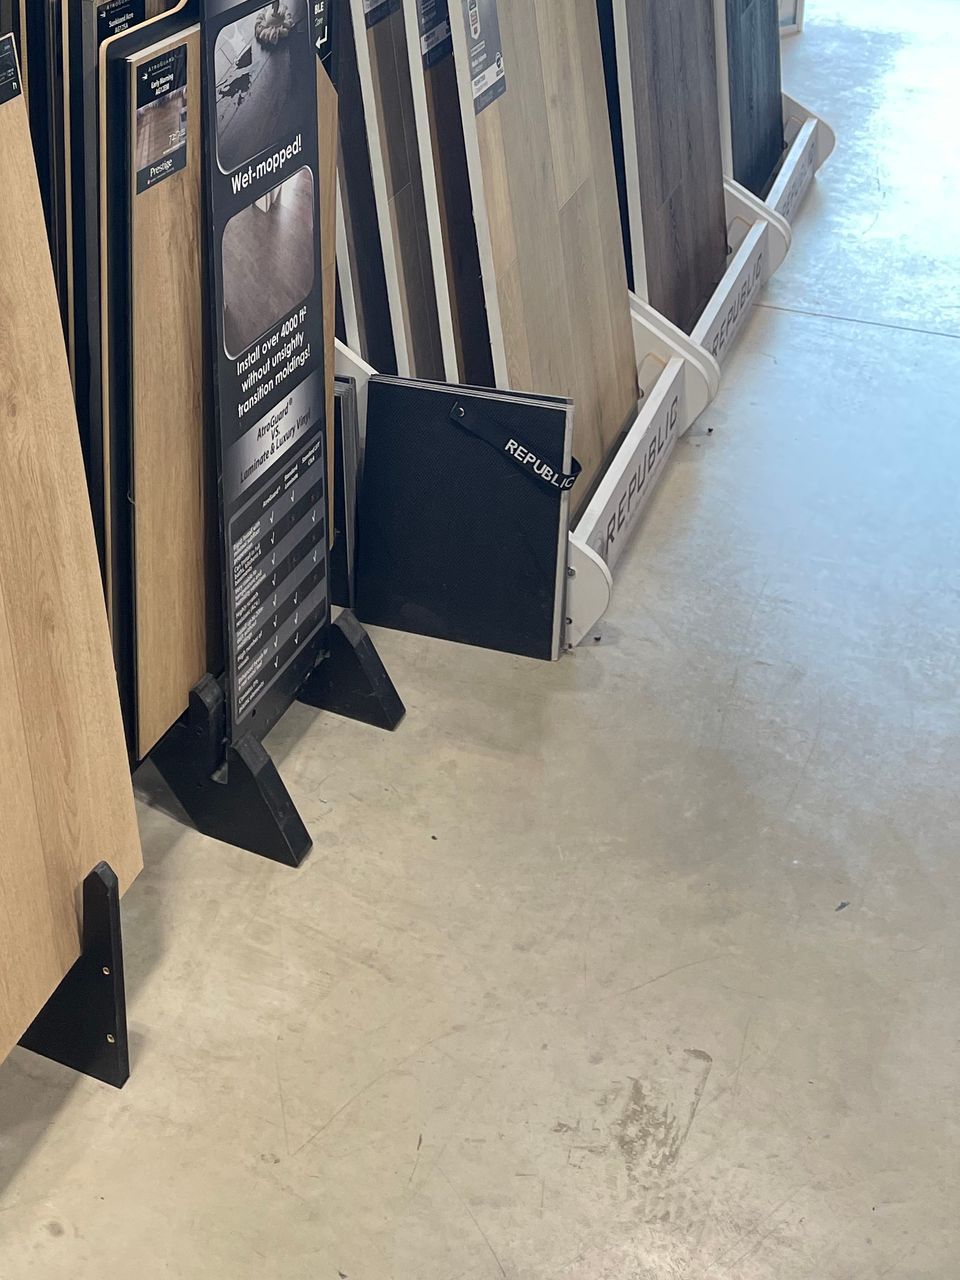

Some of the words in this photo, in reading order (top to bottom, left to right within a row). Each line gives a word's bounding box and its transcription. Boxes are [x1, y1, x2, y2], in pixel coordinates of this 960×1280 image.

[150, 159, 173, 177] Prestige
[231, 133, 302, 195] Wet-mopped!
[711, 253, 762, 357] REPUBLIC
[236, 345, 260, 376] Install
[261, 332, 279, 354] over
[280, 314, 298, 338] 4000
[241, 358, 270, 393] without
[271, 332, 304, 367] unsightly
[238, 379, 274, 418] transition
[275, 343, 310, 386] moldings!
[240, 450, 269, 484] Laminate
[270, 442, 275, 455] &
[276, 426, 295, 450] Luxury
[297, 407, 311, 429] Vinyl
[504, 438, 575, 489] REPUBLIC
[605, 396, 678, 554] REPUBLIC
